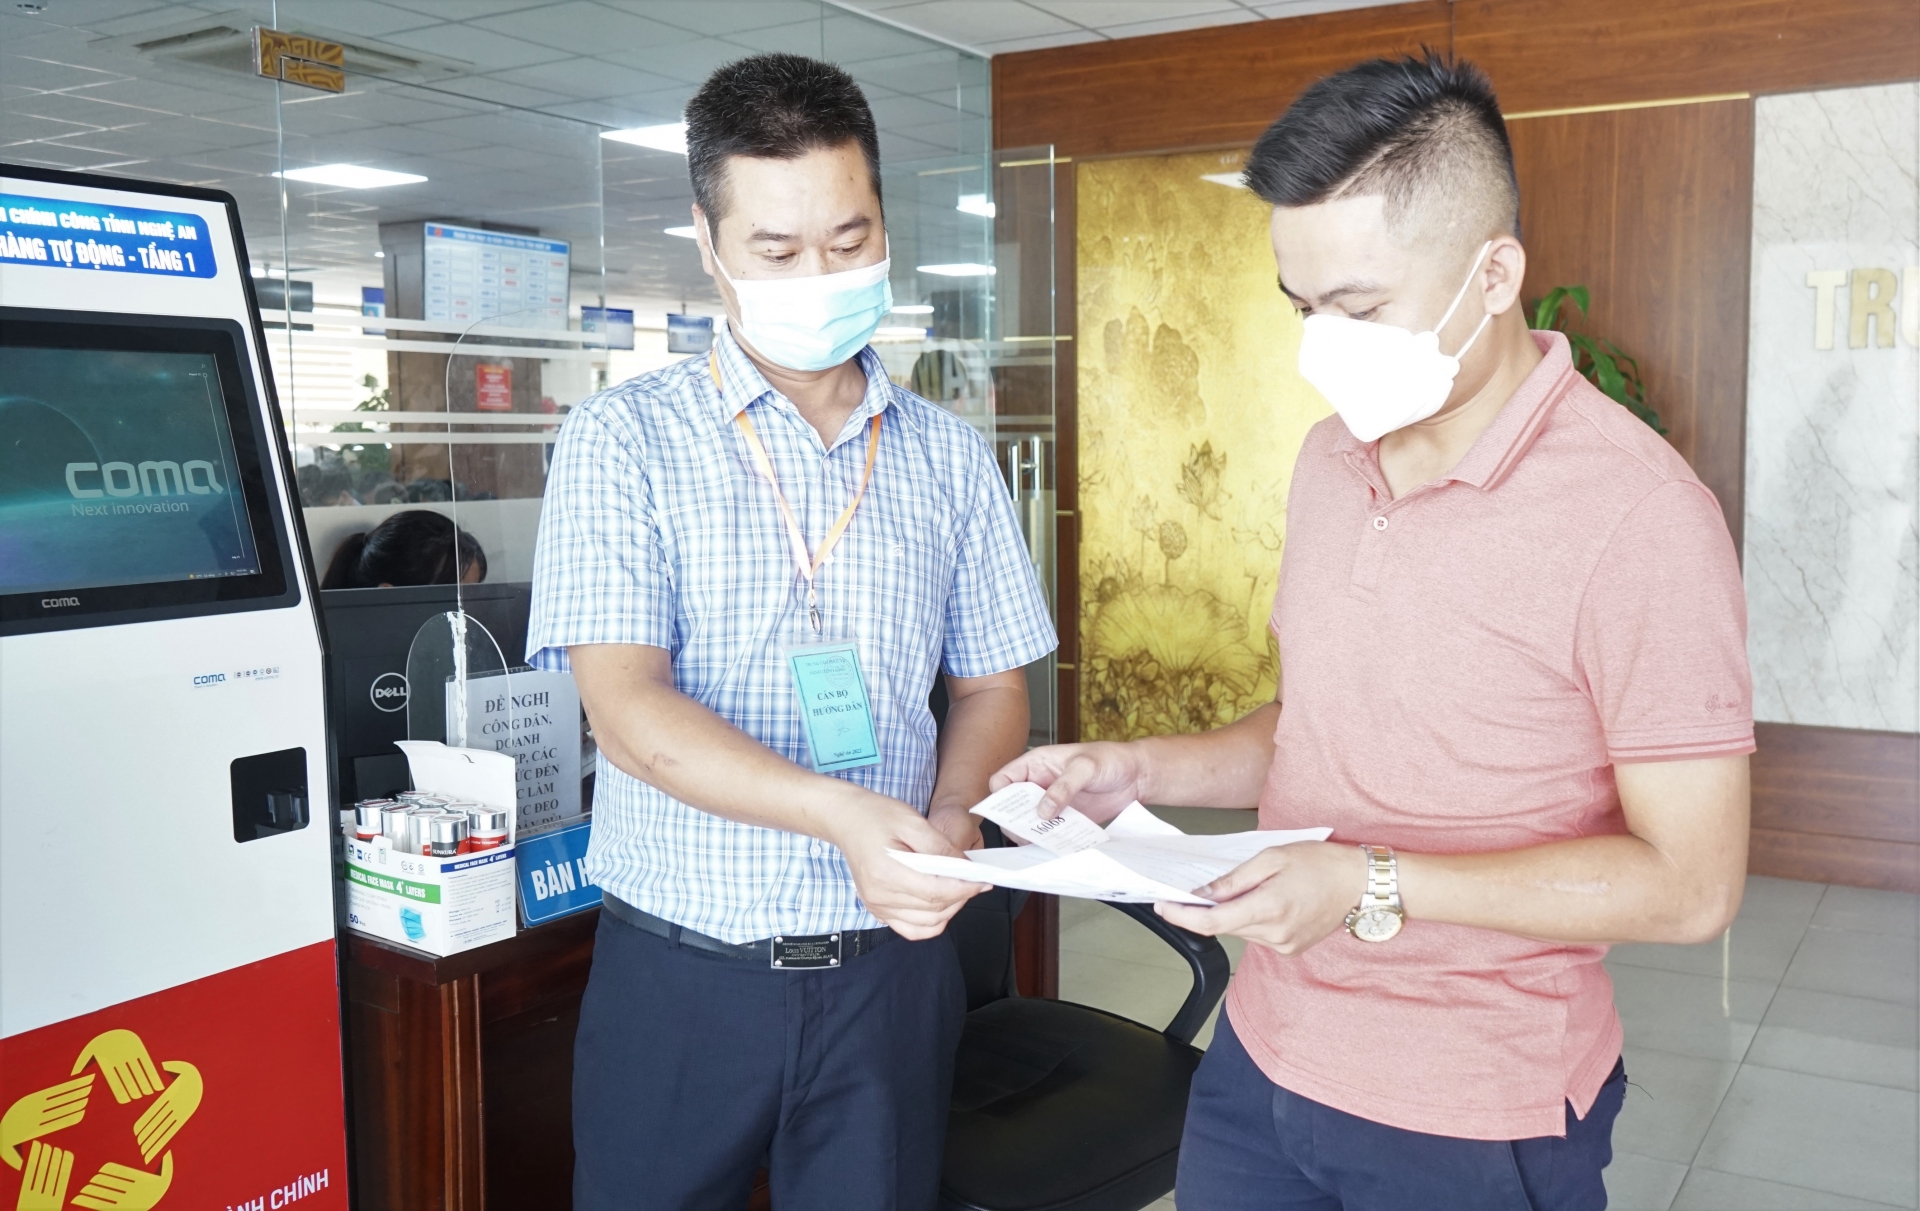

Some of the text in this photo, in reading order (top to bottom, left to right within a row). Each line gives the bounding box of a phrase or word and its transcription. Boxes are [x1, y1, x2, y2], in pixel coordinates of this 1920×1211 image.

[59, 211, 101, 231] CÔNG
[102, 213, 136, 234] TỈNH
[137, 221, 175, 241] NGHỆ
[178, 225, 197, 241] AN
[48, 239, 74, 267] TỰ
[75, 238, 126, 269] ĐỘNG
[137, 241, 184, 272] TẦNG
[185, 252, 195, 272] 1
[71, 501, 189, 517] Next innovation
[41, 597, 80, 608] coma
[193, 673, 226, 685] coma
[375, 687, 407, 698] DELL
[817, 689, 849, 701] CÁN BỘ
[485, 691, 549, 713] ĐỀ NGHỊ
[812, 704, 844, 716] HƯỚNG
[482, 712, 552, 735] CÔNG DÂN,
[496, 733, 540, 751] DOANH
[532, 746, 557, 762] CÁC
[535, 763, 560, 779] ĐẾN
[528, 781, 554, 798] LÀM
[535, 799, 559, 814] ĐEO
[367, 875, 379, 886] FACE
[379, 878, 394, 891] MASK
[405, 885, 426, 898] LAYERS
[531, 860, 576, 901] BÀN
[349, 913, 359, 924] 50
[799, 946, 827, 954] VUITTON
[270, 1168, 329, 1210] CHÍNH
